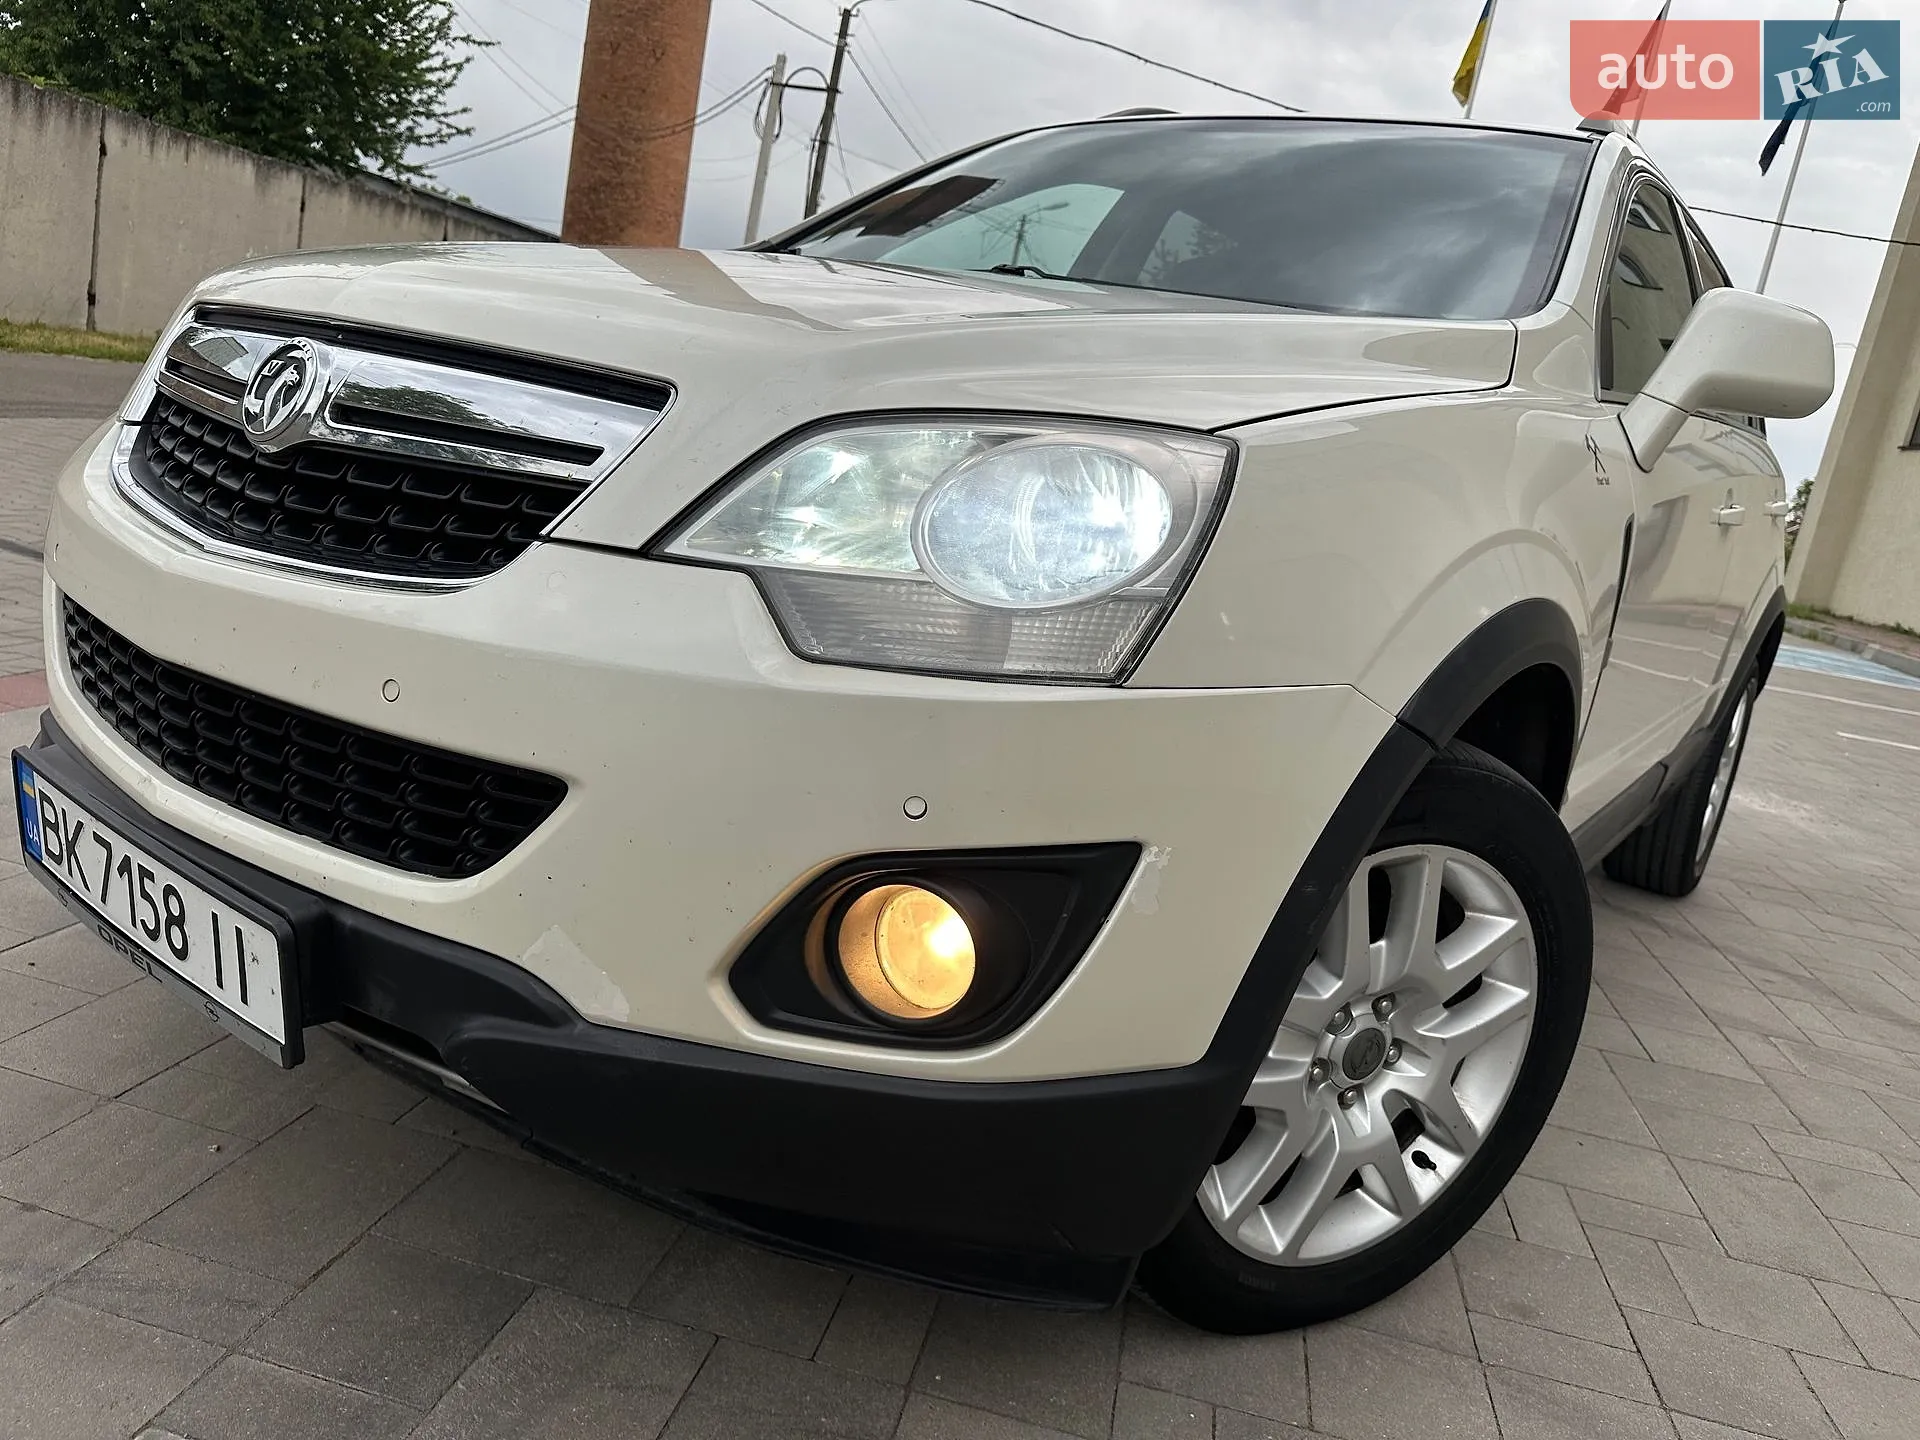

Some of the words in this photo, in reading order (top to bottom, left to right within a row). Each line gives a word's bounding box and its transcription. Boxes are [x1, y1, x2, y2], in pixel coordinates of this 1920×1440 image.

[26, 816, 40, 847] UA
[38, 788, 91, 893] BK
[92, 830, 190, 961] 7158
[97, 923, 163, 984] OPEL
